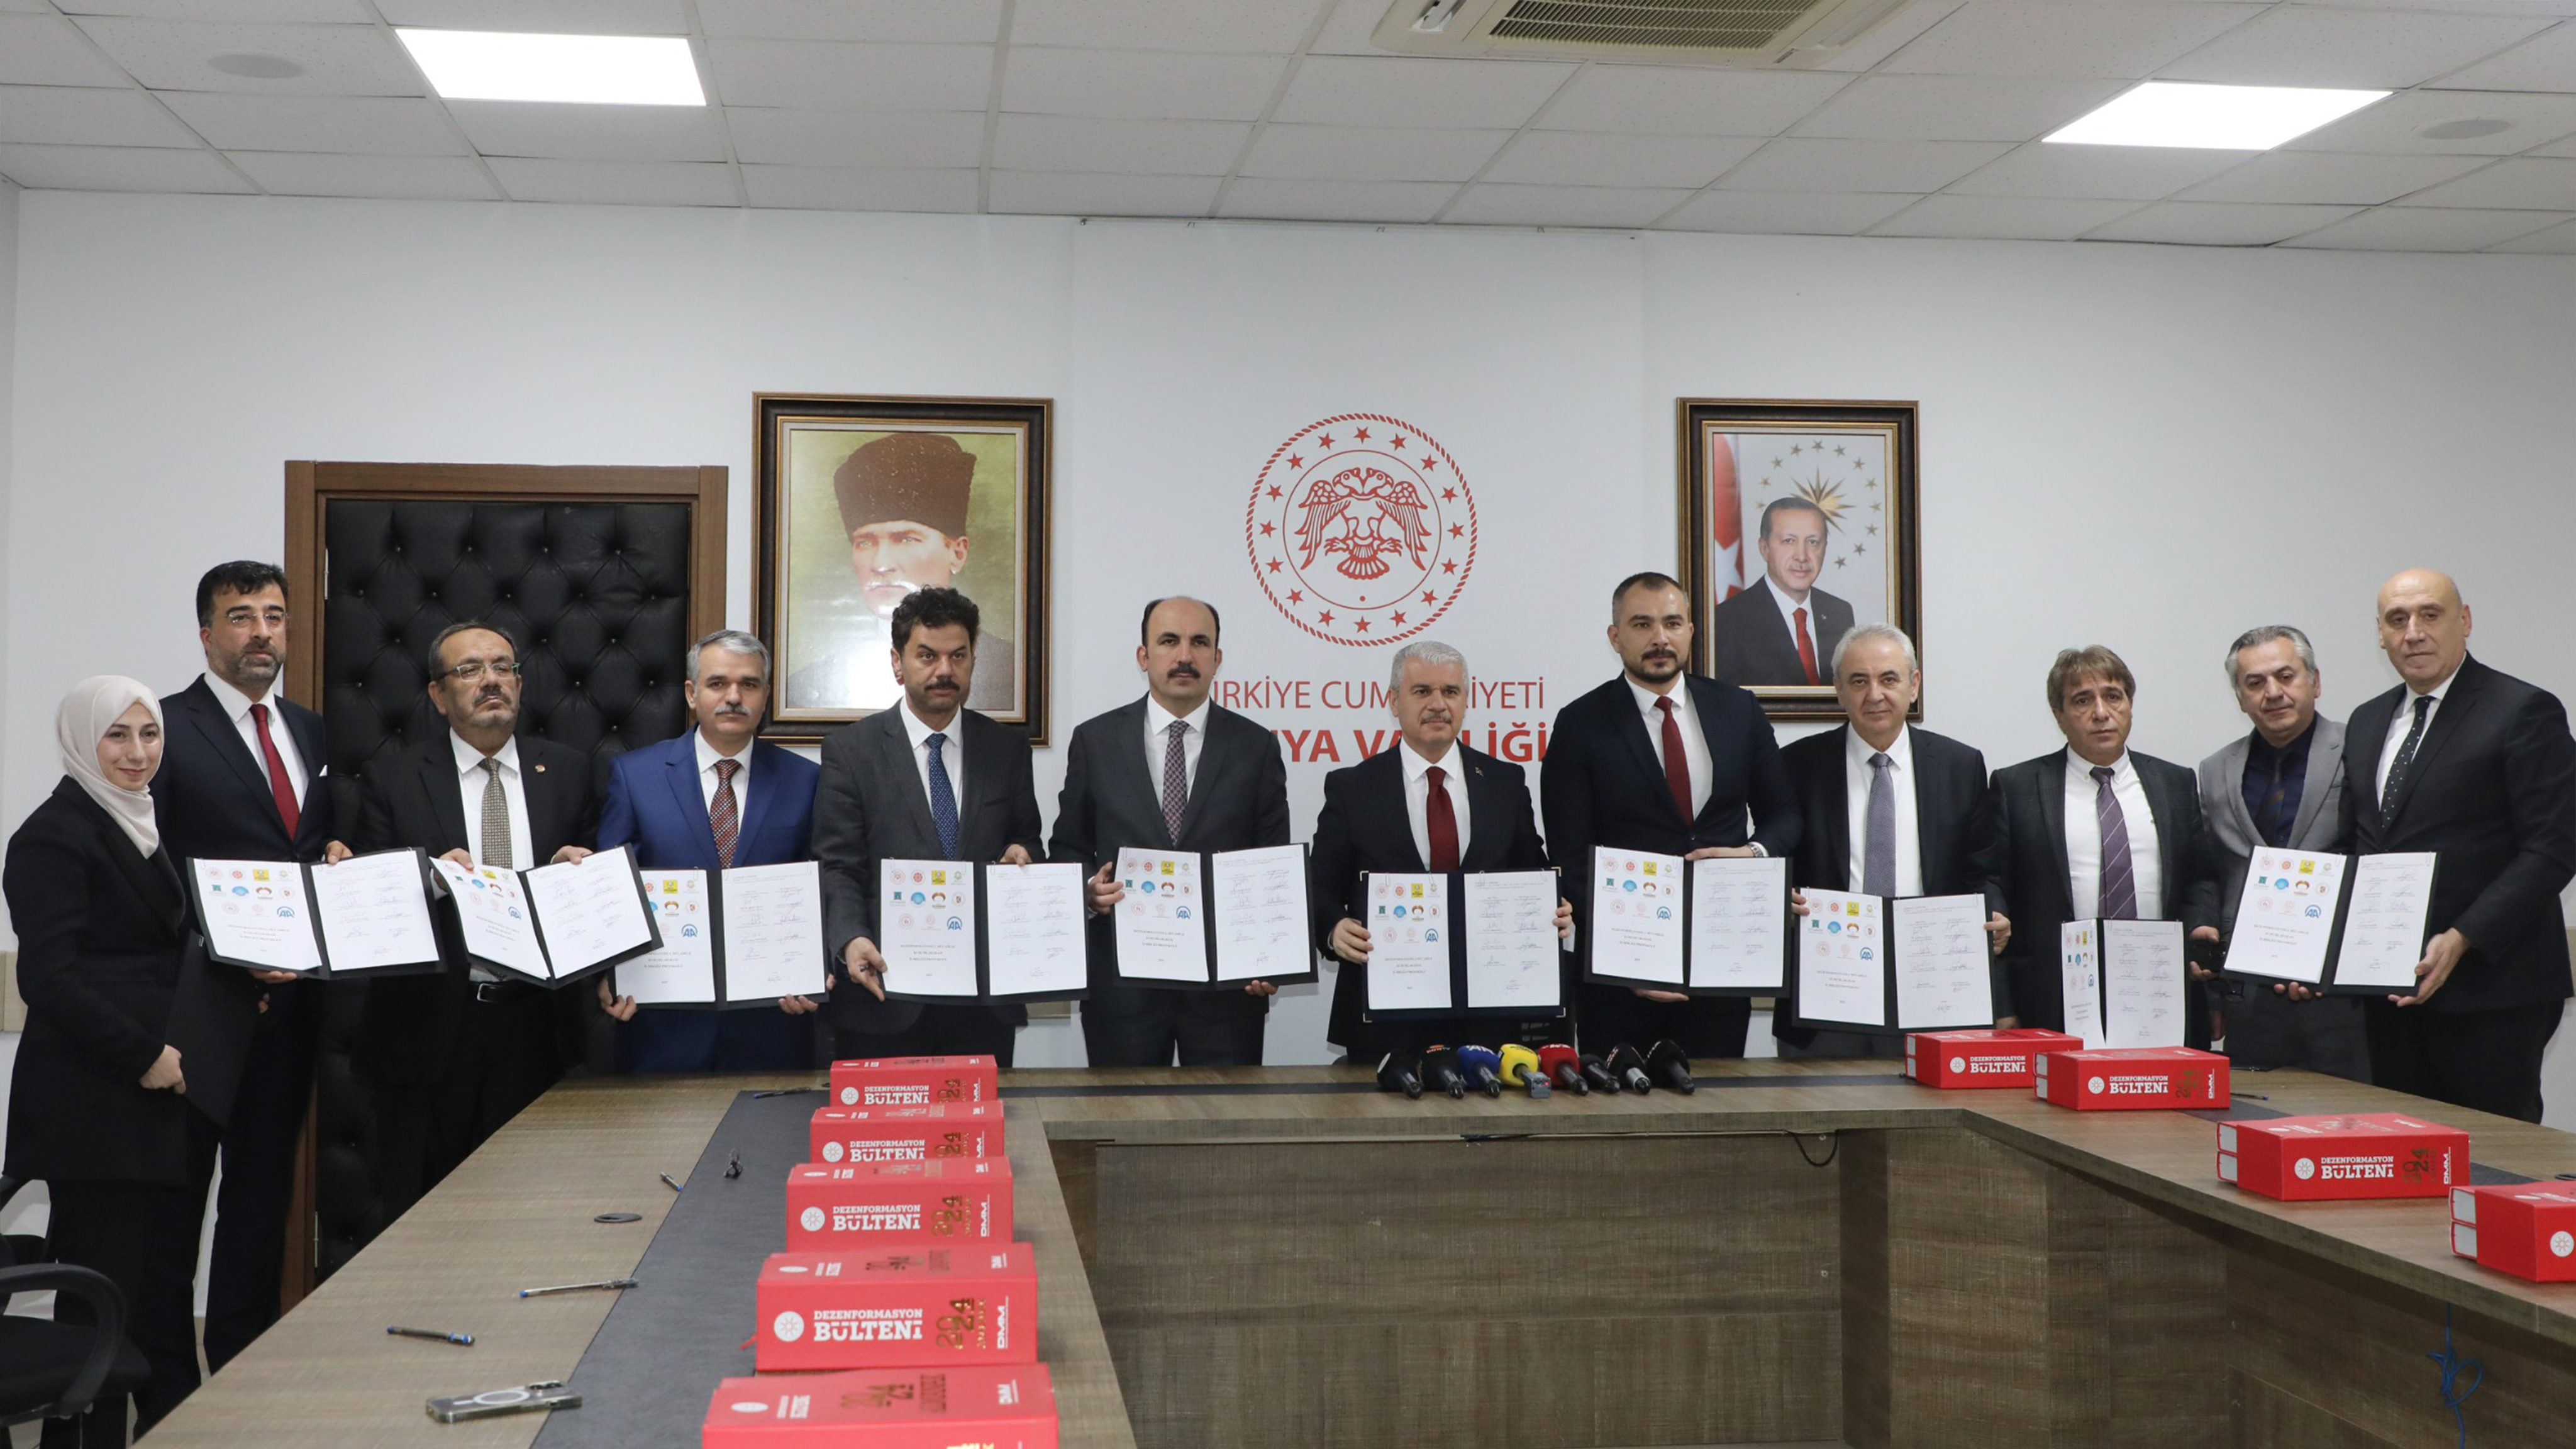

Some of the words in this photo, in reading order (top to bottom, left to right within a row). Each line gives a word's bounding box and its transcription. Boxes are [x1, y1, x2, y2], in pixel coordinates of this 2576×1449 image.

[1970, 1062, 2026, 1074] BÜLTENİ
[2109, 1082, 2168, 1094] BÜLTENİ
[864, 1092, 930, 1105] BÜLTENİ
[850, 1140, 925, 1148] DEZENFORMASYON
[850, 1147, 925, 1162] BÜLTENİ
[2321, 1156, 2394, 1164] DEZENFORMASYON
[2321, 1163, 2394, 1179] BÜLTENİ
[833, 1204, 921, 1214] DEZENFORMASYON
[833, 1213, 921, 1231] BÜLTENİ
[814, 1308, 923, 1320] DEZENFORMASYON
[814, 1319, 923, 1341] BÜLTENİ
[997, 1306, 1006, 1349] DMM
